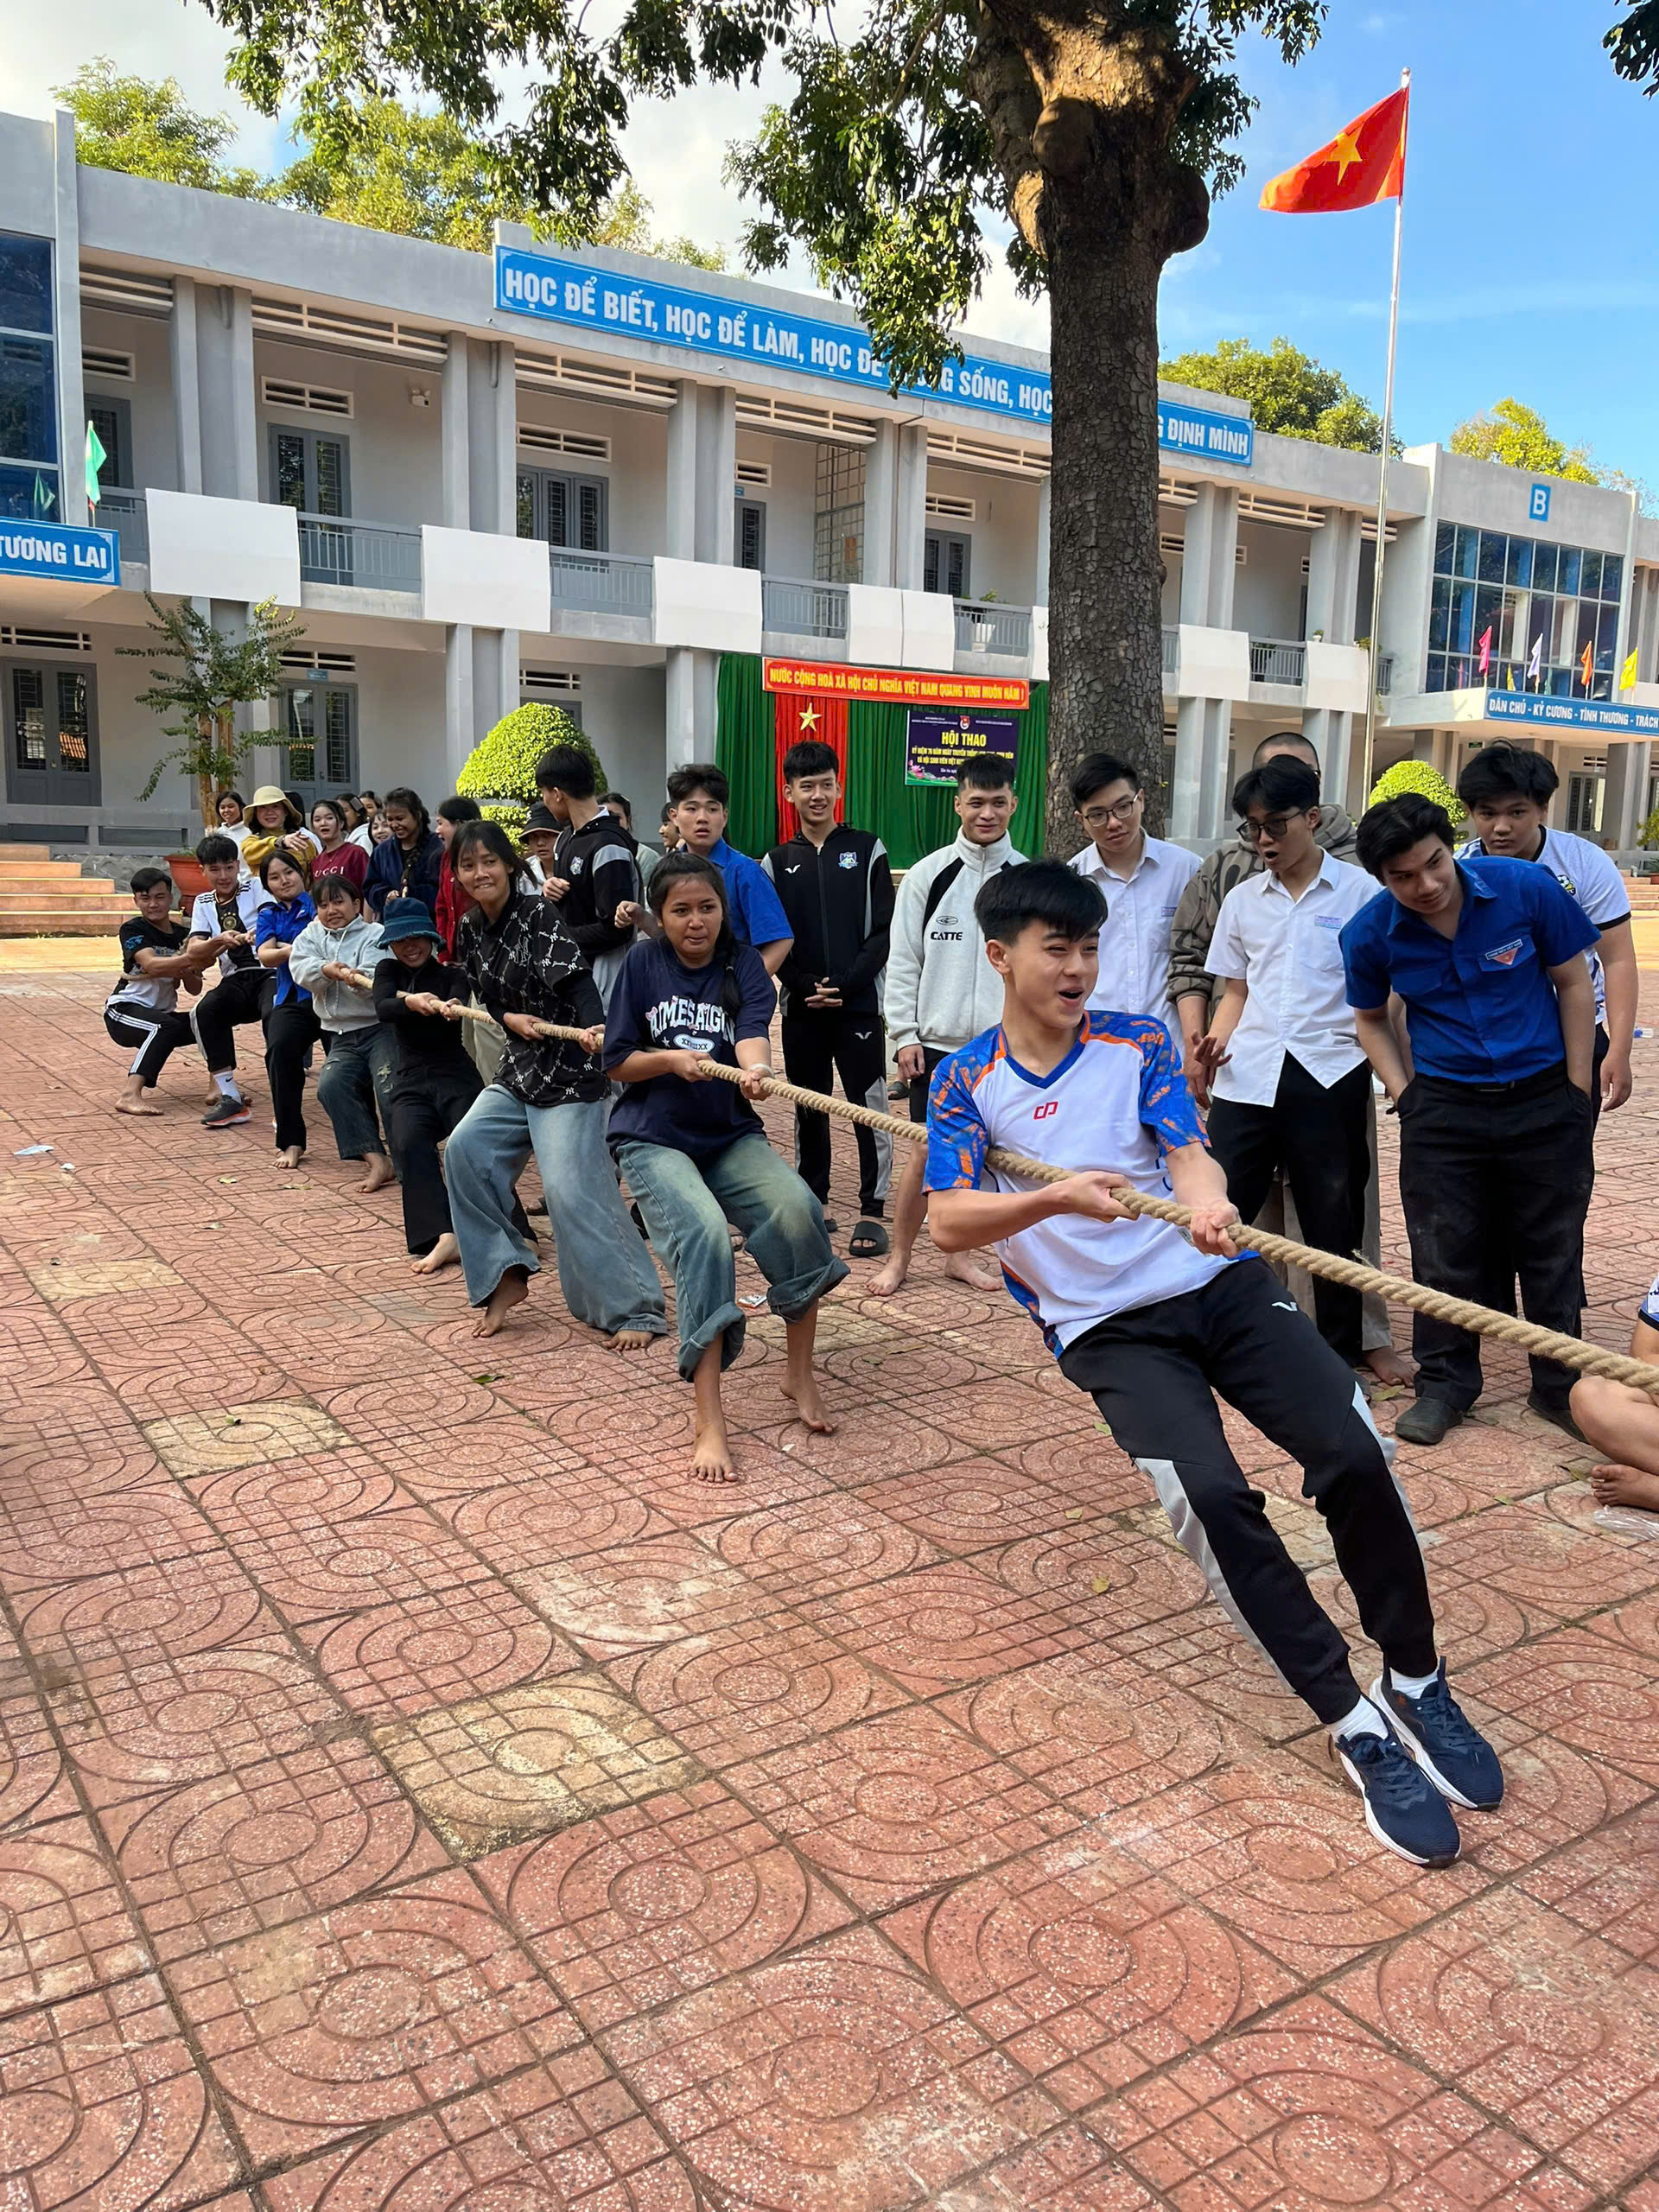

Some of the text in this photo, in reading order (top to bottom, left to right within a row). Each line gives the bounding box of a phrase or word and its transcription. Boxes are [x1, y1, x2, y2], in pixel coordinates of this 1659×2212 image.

[505, 268, 557, 309] HỌC
[565, 276, 598, 317] ĐỂ
[604, 289, 658, 333] BIẾT,
[666, 304, 711, 342] HỌC
[718, 310, 747, 347] ĐỂ
[753, 322, 804, 363] LÀM,
[811, 338, 852, 373] HỌC
[958, 366, 1014, 409] SỐNG,
[1019, 384, 1052, 416] HỌC
[1167, 418, 1205, 447] ĐỊNH
[1209, 425, 1249, 456] MÌNH
[1532, 489, 1548, 517] B
[73, 544, 107, 569] LAI
[1489, 697, 1508, 713] DÂN
[1509, 698, 1526, 715] CHỦ
[1545, 705, 1573, 720] CƯƠNG
[1599, 711, 1629, 726] THƯƠNG
[941, 730, 987, 748] HỘI THAO
[315, 866, 345, 878] UCCI
[930, 931, 963, 941] CATTE
